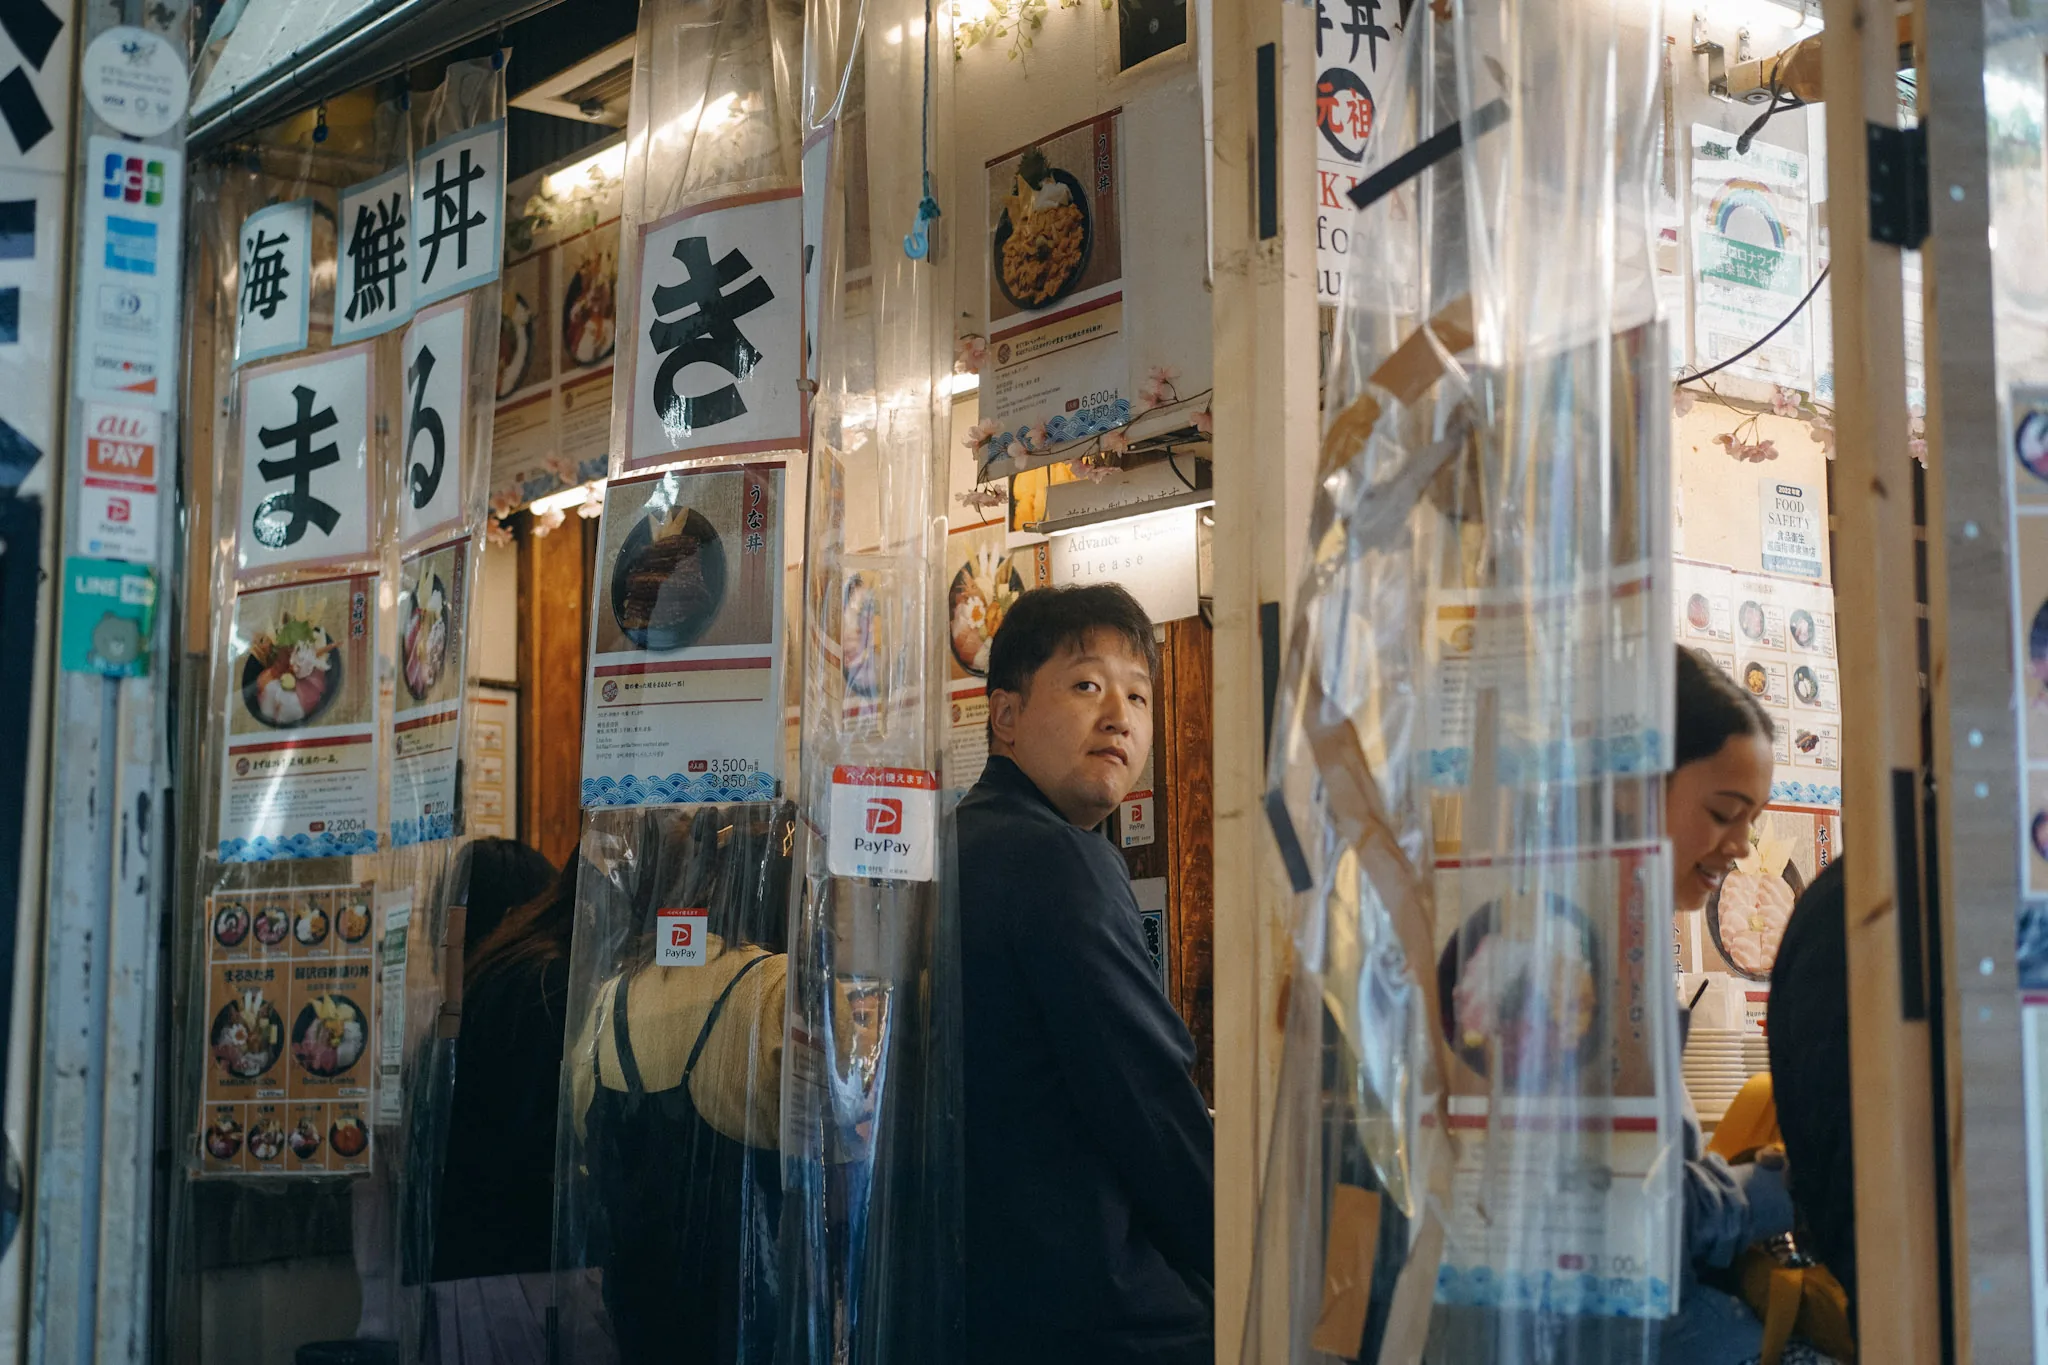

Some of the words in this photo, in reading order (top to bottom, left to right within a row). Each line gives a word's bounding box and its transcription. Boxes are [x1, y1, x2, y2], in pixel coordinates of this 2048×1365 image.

[1316, 82, 1373, 140] 元祖
[1098, 134, 1110, 192] うに丼
[649, 237, 775, 430] き
[98, 415, 147, 437] au
[98, 442, 145, 469] PAY
[1775, 498, 1805, 513] FOOD
[745, 485, 765, 555] うな丼
[1768, 512, 1809, 530] SAFETY
[1068, 533, 1121, 553] Advance
[1071, 554, 1145, 578] Please
[76, 576, 118, 596] LINE
[854, 837, 911, 856] PayPay
[665, 948, 697, 959] PayPay
